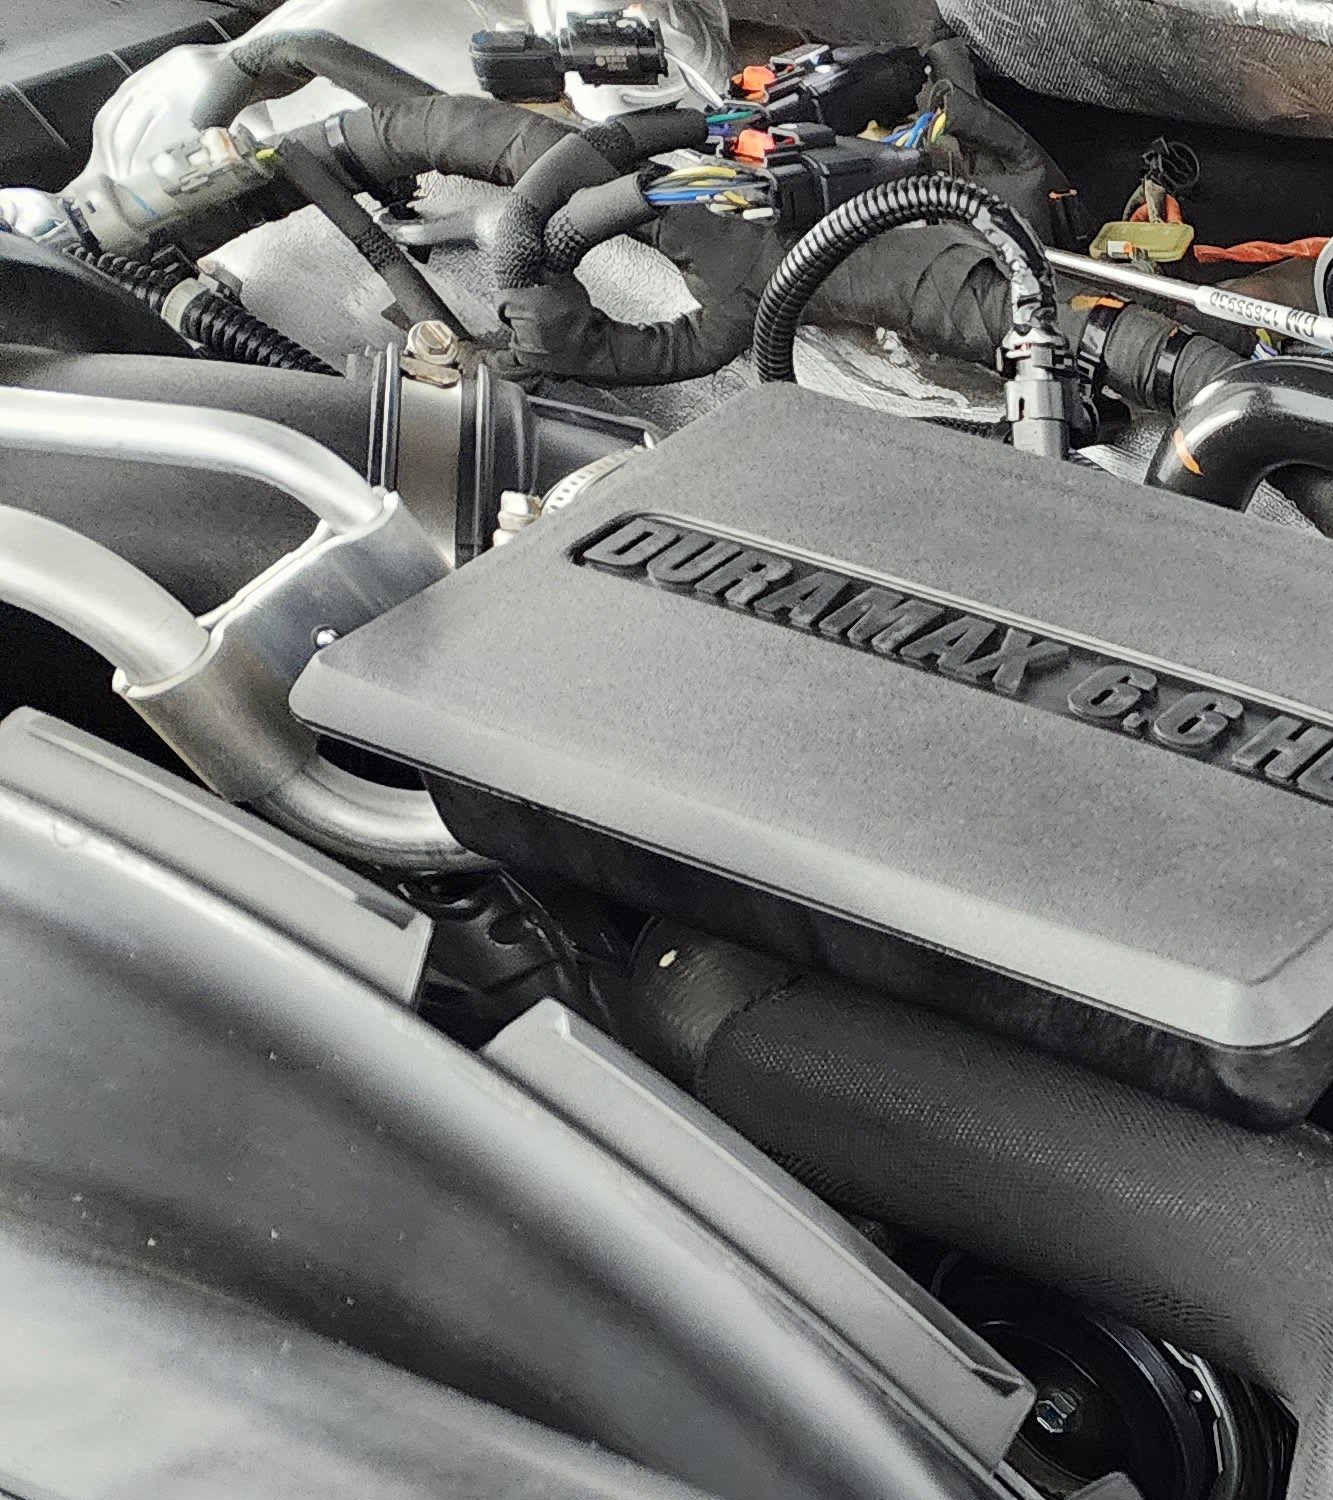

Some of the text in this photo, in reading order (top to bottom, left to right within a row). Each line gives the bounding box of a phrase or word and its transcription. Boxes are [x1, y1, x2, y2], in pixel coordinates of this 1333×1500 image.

[1285, 309, 1318, 338] GM
[582, 518, 1069, 695] DURAMAX
[1067, 664, 1245, 750] 6.6
